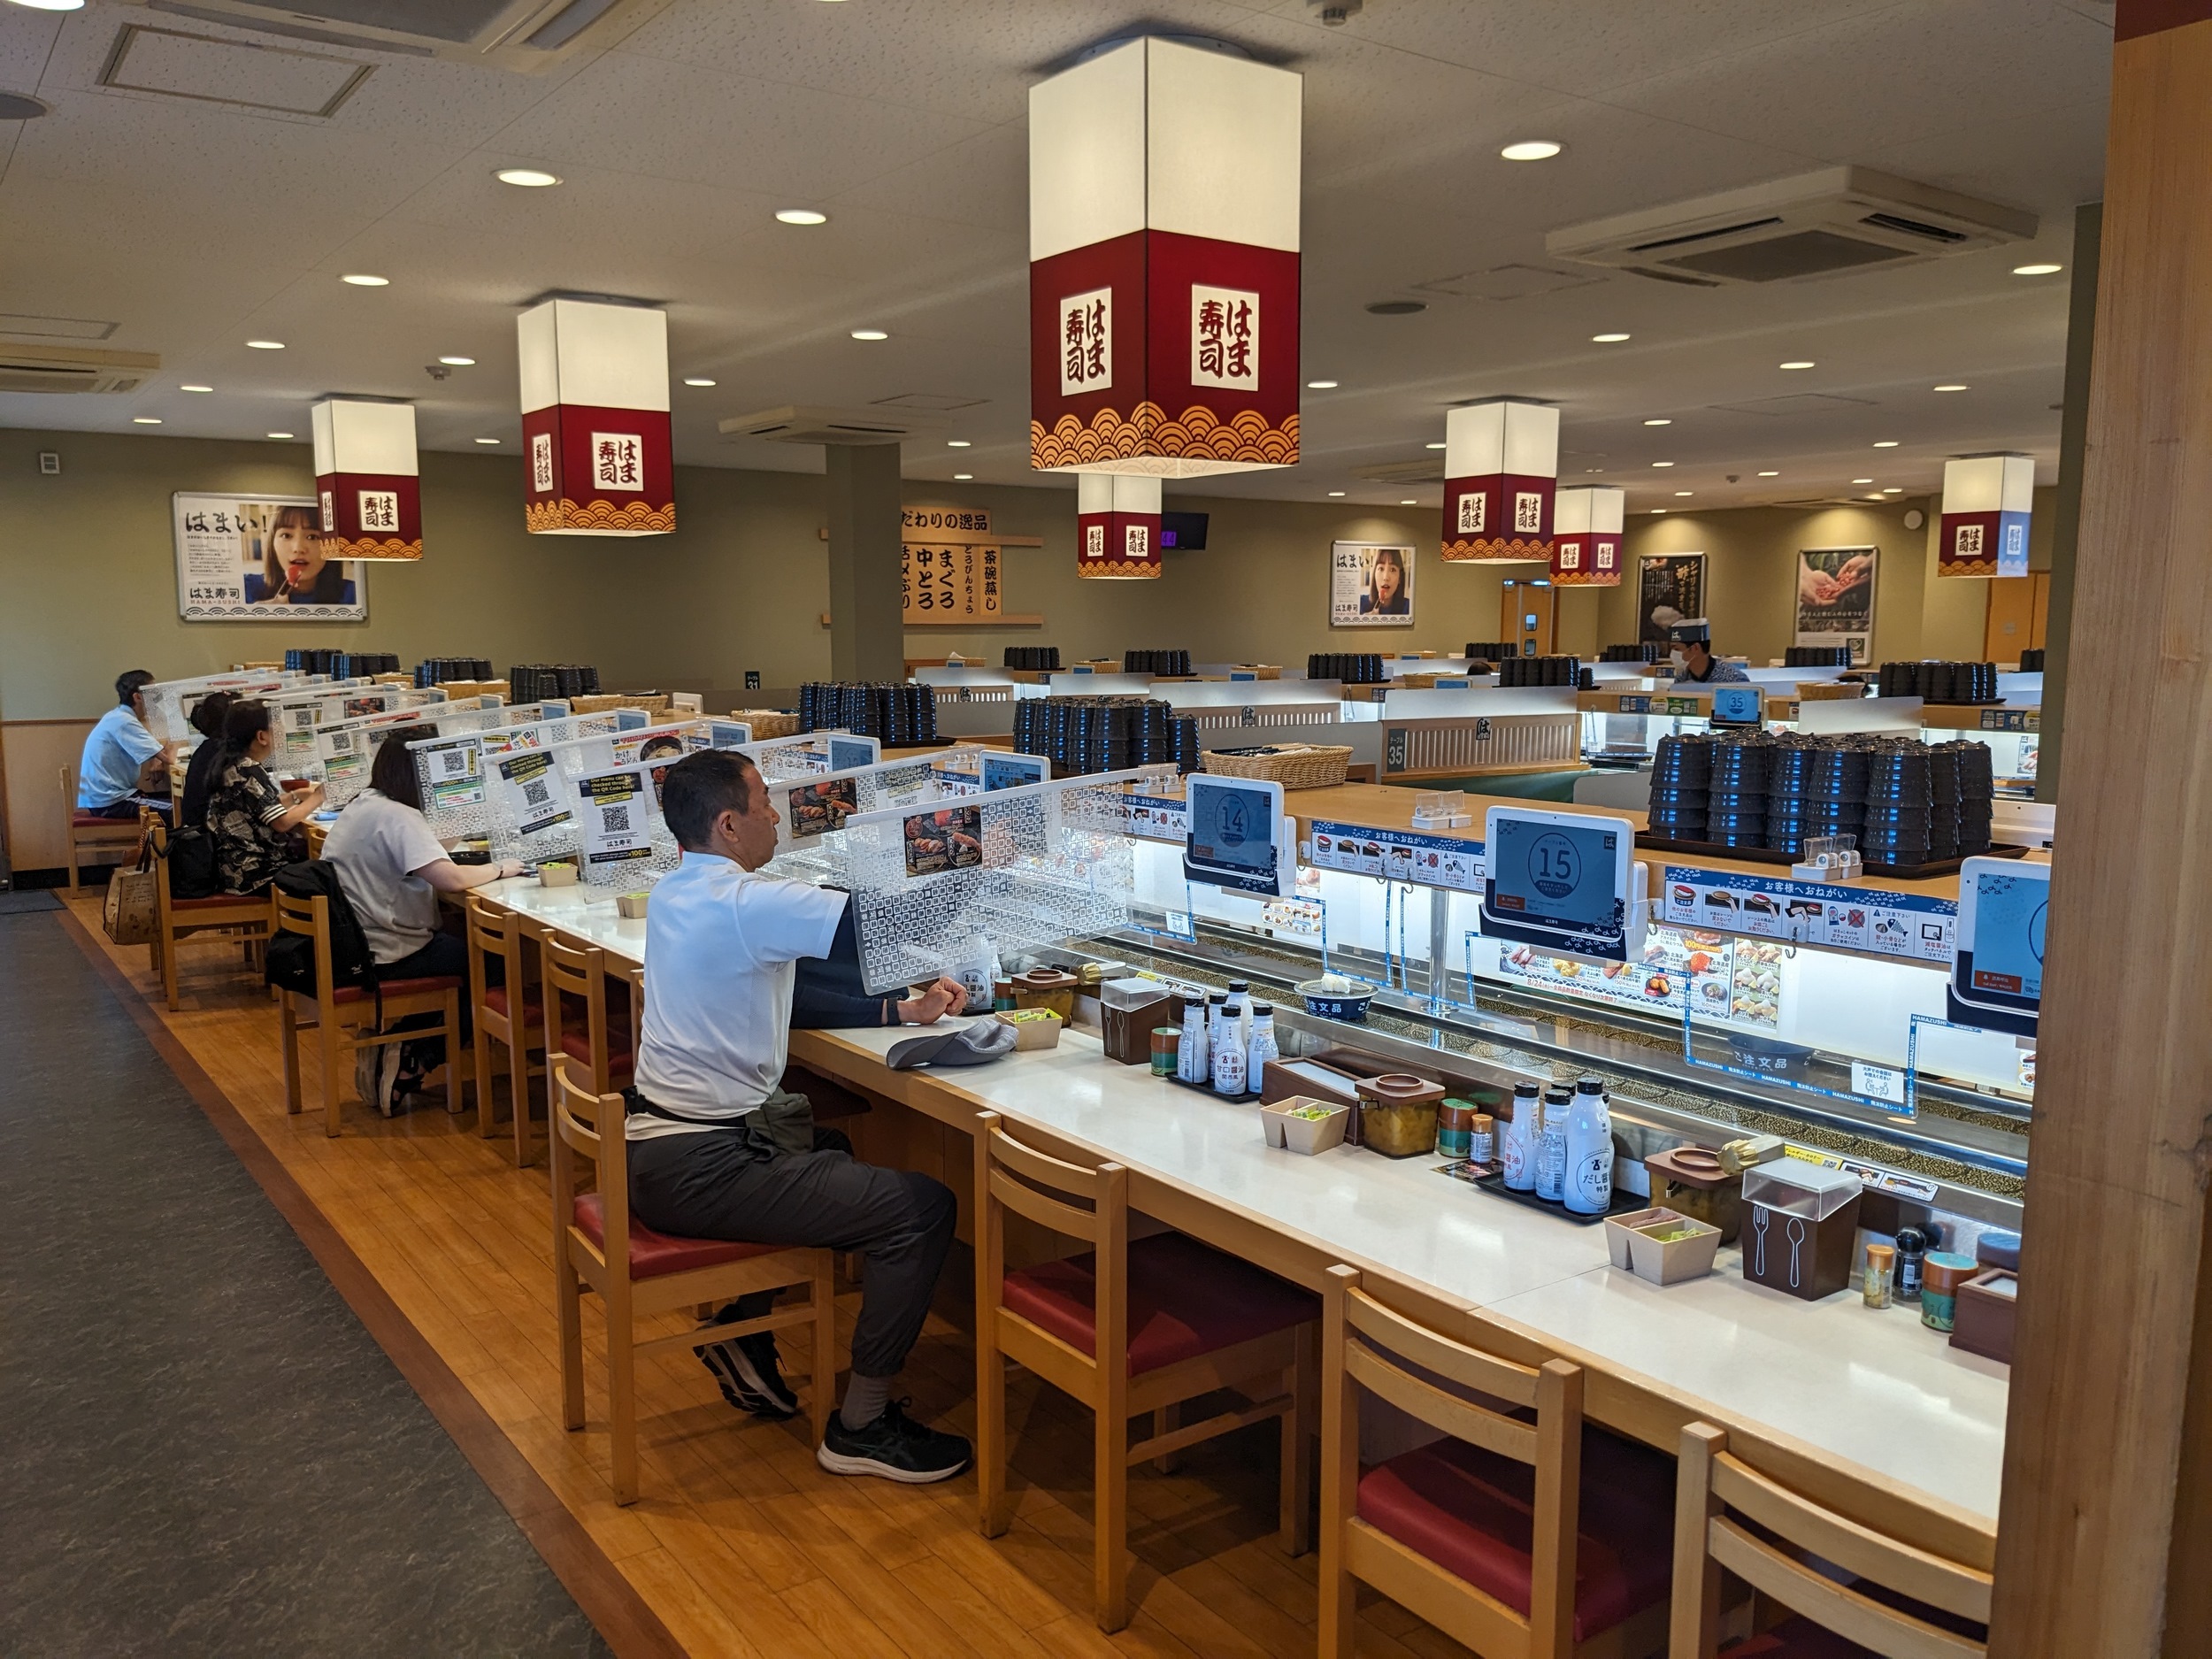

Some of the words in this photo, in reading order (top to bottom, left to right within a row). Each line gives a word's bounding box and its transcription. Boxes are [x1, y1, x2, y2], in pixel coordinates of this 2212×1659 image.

[1066, 309, 1085, 384] 寿司
[1087, 299, 1106, 379] はま
[1199, 300, 1224, 380] 寿司
[1226, 300, 1253, 379] はま
[599, 441, 618, 485] 寿司
[618, 440, 638, 483] はま
[186, 511, 268, 534] はまい!
[365, 496, 379, 527] 寿司
[380, 495, 395, 526] はま
[1461, 499, 1471, 529] 寿司
[1471, 496, 1482, 527] はま
[1518, 498, 1528, 528] 寿司
[1528, 497, 1539, 527] はま
[1129, 530, 1137, 554] 寿司
[1137, 529, 1146, 553] はま
[1959, 530, 1970, 552] 寿司
[1970, 528, 1981, 551] はま
[1336, 553, 1373, 568] はまい!
[917, 548, 934, 610] 中とろ
[939, 549, 956, 610] まぐろ
[984, 550, 997, 611] 茶碗蒸し
[190, 587, 240, 599] はま寿司
[1731, 697, 1743, 707] 35
[1389, 746, 1403, 765] 35
[1222, 806, 1243, 832] 14
[1375, 832, 1428, 845] お客様へおねがい
[1540, 848, 1571, 879] 15
[1765, 881, 1847, 898] お客様へおねがい
[1309, 998, 1342, 1013] 注文品
[1912, 1015, 1947, 1026] HAMAZUSHI
[1217, 1065, 1244, 1073] 甘口醤油
[1734, 1051, 1787, 1069] ご注文品
[1863, 1067, 1892, 1076] 大声での会話は
[1695, 1059, 1723, 1070] HAMAZUSHI
[1728, 1067, 1756, 1078] 飛沫防止シート
[1761, 1075, 1791, 1087] HAMAZUSHI
[1797, 1082, 1827, 1094] 飛沫防止シート
[1832, 1091, 1865, 1103] HAMAZUSHI
[1870, 1100, 1903, 1112] 飛沫防止シート
[1864, 1072, 1891, 1081] お控えください
[1596, 1184, 1609, 1193] 特製
